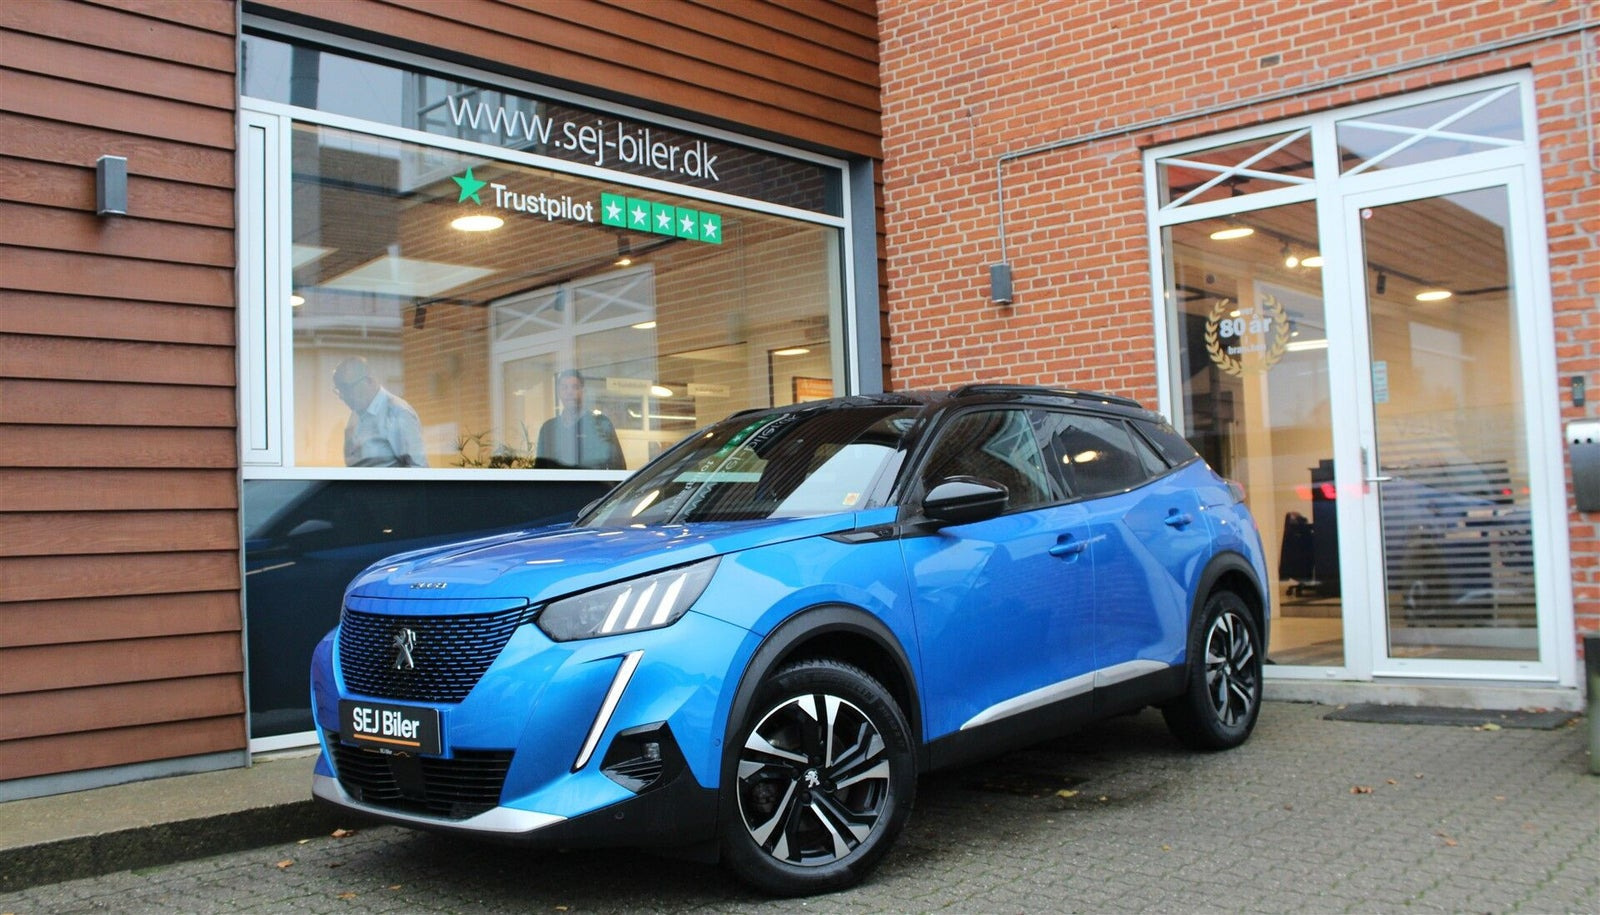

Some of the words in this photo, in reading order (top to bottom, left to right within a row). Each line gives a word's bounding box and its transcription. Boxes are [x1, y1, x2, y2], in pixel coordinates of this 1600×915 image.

[448, 95, 720, 181] www.sej-biler.dk
[490, 183, 593, 222] Trustpilot
[1219, 318, 1246, 338] 80
[1249, 314, 1272, 334] år
[353, 707, 379, 733] SEJ
[383, 711, 419, 738] Biler
